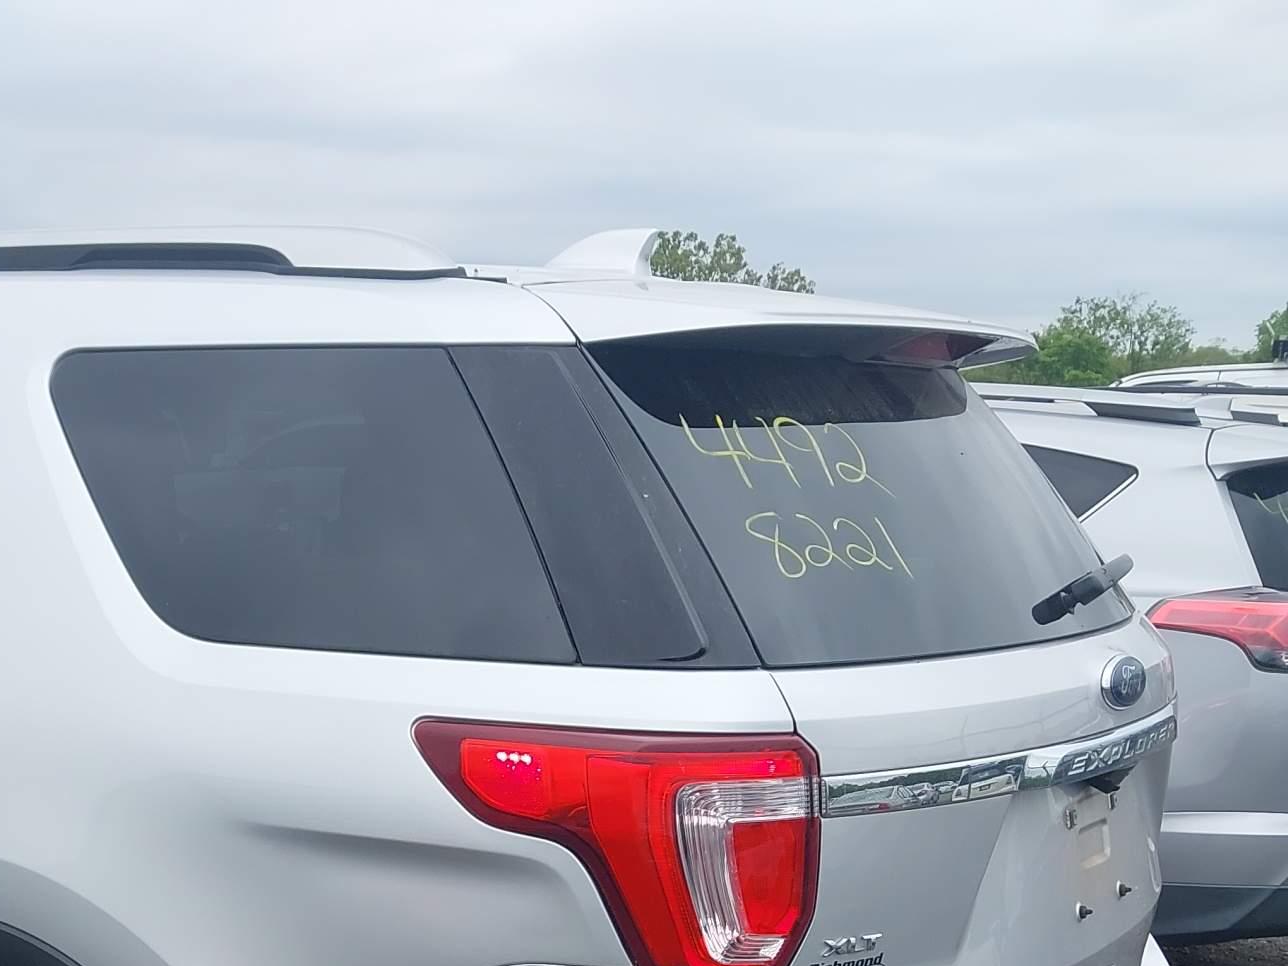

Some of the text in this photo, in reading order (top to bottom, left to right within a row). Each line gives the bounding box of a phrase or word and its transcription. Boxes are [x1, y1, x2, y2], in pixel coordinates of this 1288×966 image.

[678, 413, 896, 498] 4492
[745, 511, 914, 579] 8221
[822, 933, 883, 957] XLT
